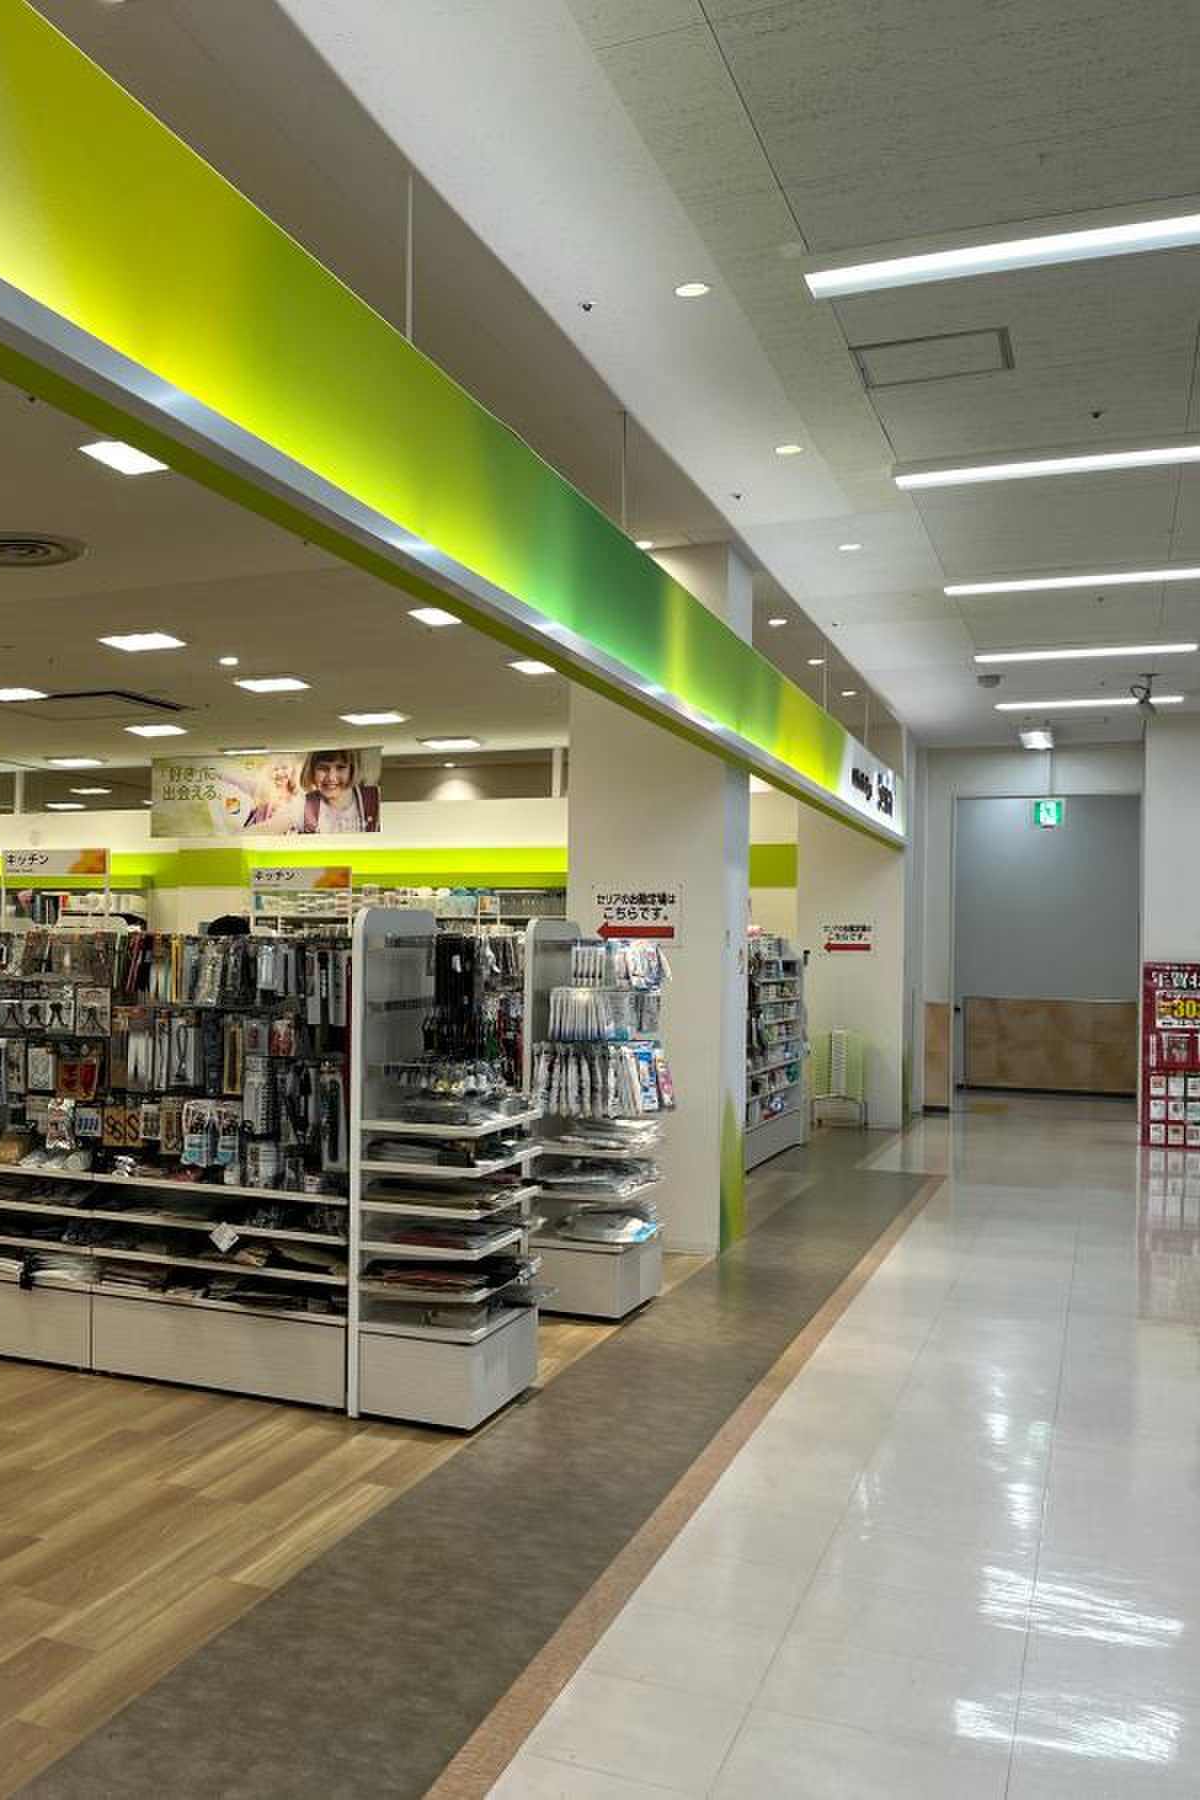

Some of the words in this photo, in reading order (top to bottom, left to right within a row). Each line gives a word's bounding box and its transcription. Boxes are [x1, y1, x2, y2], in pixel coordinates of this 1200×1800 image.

[6, 851, 49, 866] キッチン
[603, 906, 669, 921] こちらです。
